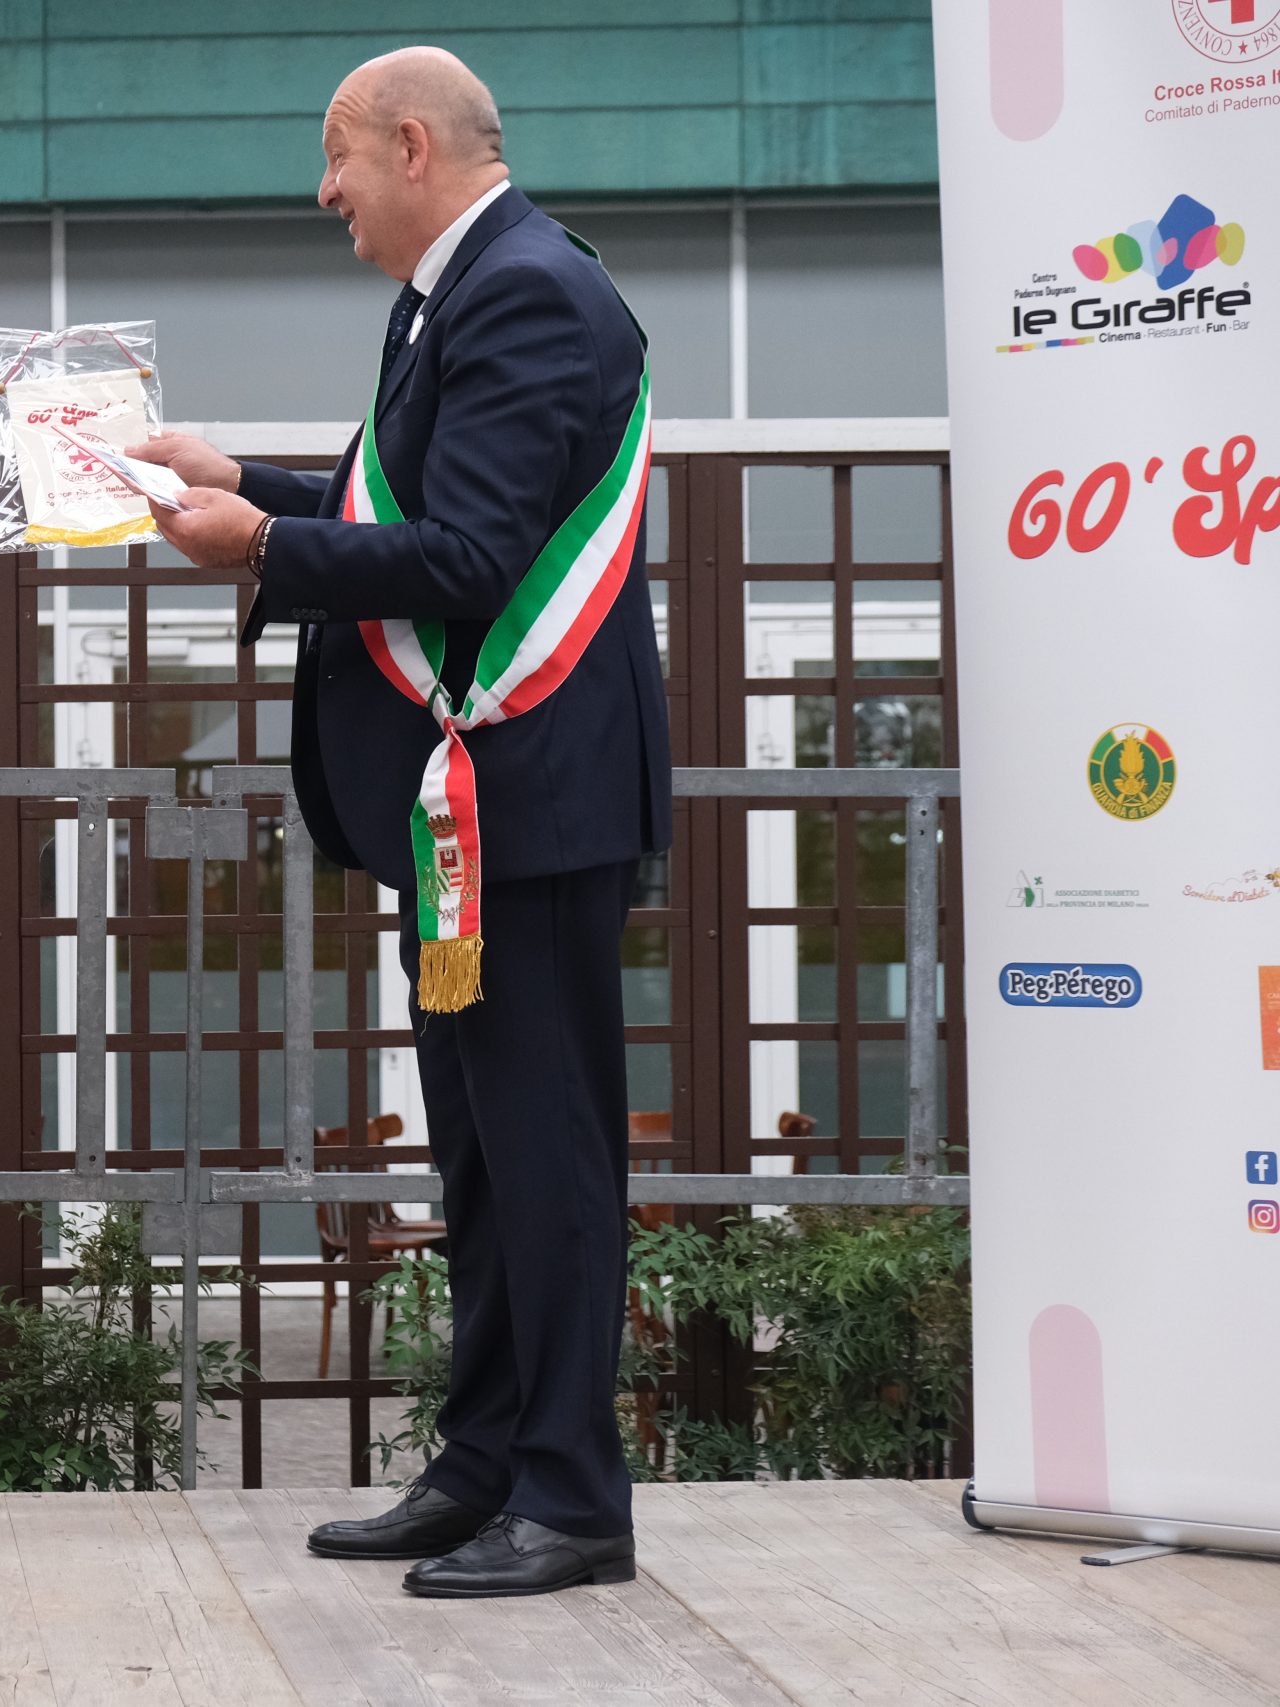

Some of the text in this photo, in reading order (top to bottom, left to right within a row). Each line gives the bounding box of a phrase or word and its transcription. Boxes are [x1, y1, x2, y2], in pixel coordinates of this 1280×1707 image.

[1154, 82, 1204, 101] Croce
[1210, 73, 1266, 93] Rossa
[1145, 94, 1280, 123] Comitato di Paderno
[1014, 284, 1077, 300] Paderno Dugnano
[1032, 273, 1057, 284] Centro
[1013, 286, 1251, 337] le Giraffe
[1099, 320, 1250, 343] Cinema Restaurant Fun Bar
[1007, 457, 1164, 560] 60'
